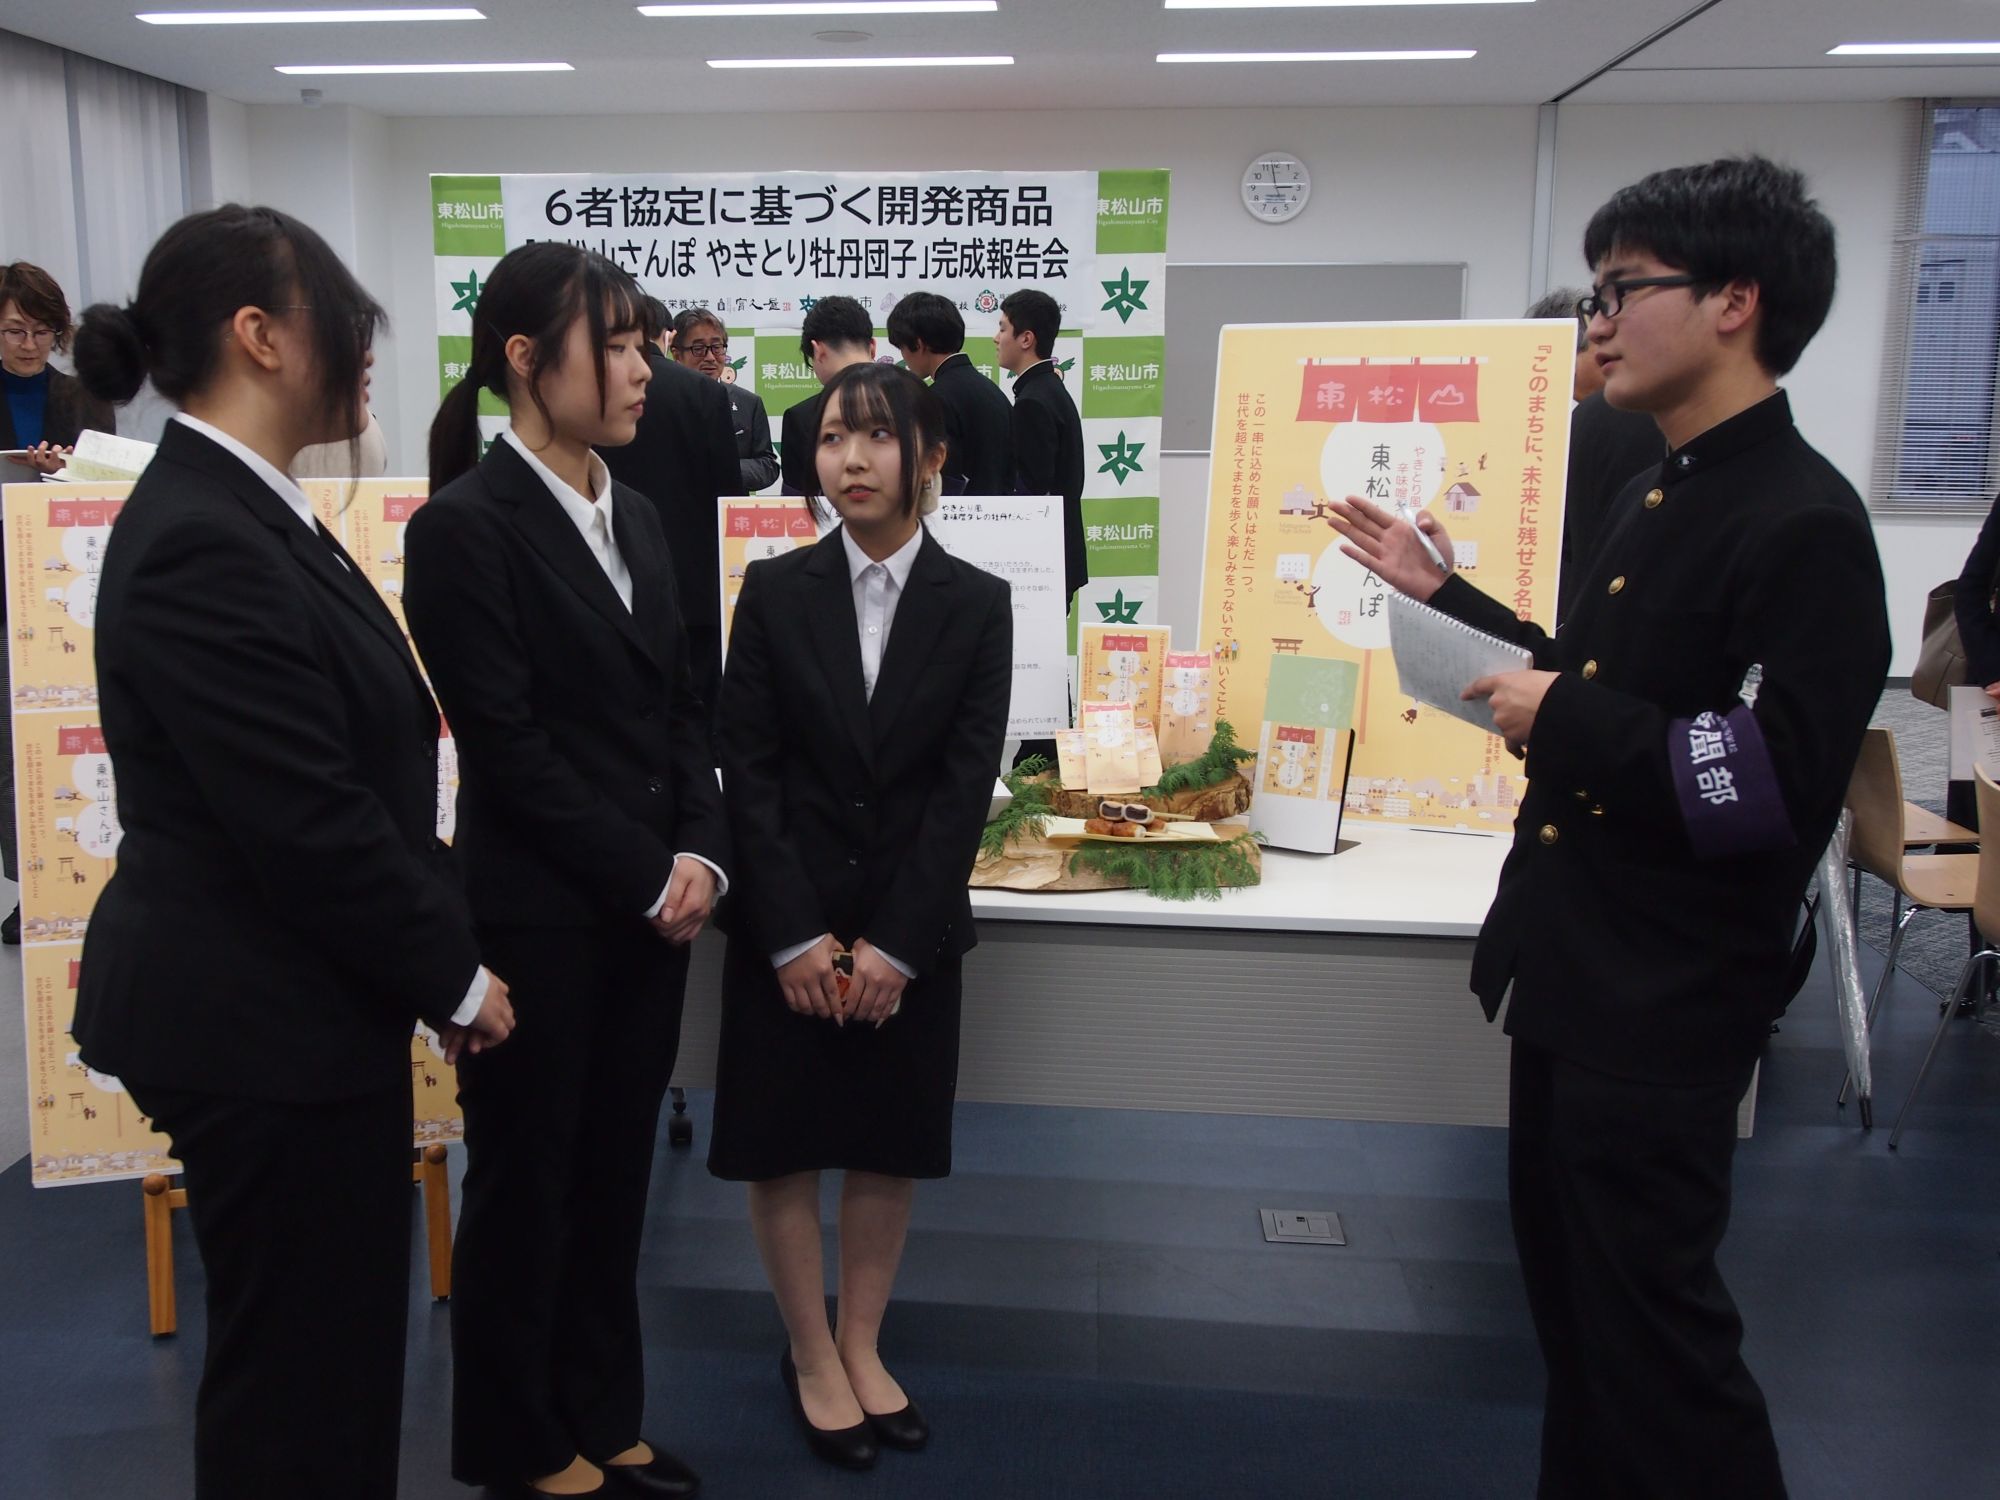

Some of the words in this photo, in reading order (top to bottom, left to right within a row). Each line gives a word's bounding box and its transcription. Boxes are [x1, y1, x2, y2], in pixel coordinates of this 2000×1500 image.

[437, 202, 504, 220] 東松山市
[544, 183, 1053, 228] 6者協定に基づく開発商品
[1096, 197, 1164, 216] 東松山市
[706, 236, 1069, 280] やきとり牡丹団子」完成報告会
[761, 363, 818, 380] 東松山
[1089, 363, 1160, 382] 東松山市
[1241, 392, 1266, 593] この一串に込めた願いはただ一つ。
[1086, 523, 1155, 542] 東松山市
[1359, 443, 1391, 618] 東松んぽ
